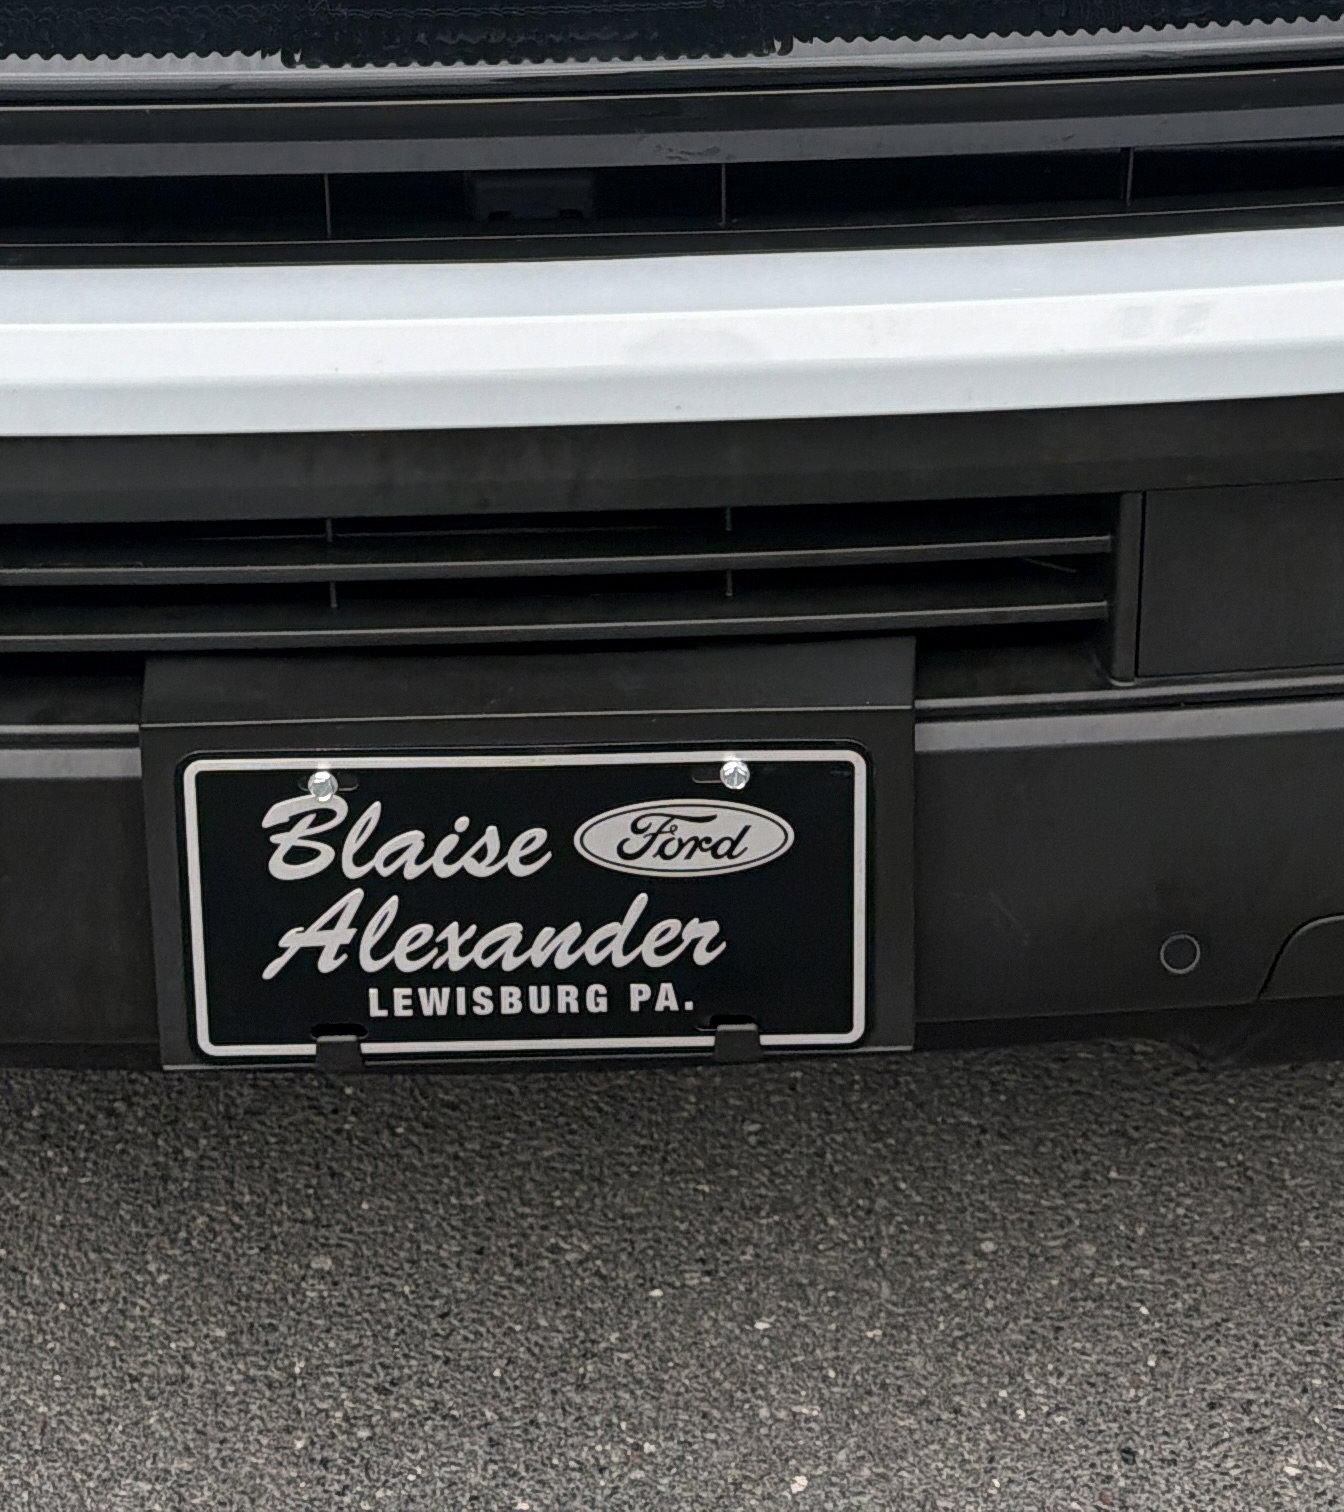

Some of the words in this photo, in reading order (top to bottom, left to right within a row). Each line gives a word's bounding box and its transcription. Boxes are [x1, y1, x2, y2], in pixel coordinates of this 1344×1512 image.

[261, 794, 553, 881] Blaise
[616, 811, 752, 863] Ford
[261, 888, 727, 981] Alexander
[368, 983, 609, 1019] LEWISBURG
[629, 982, 696, 1014] PA.
